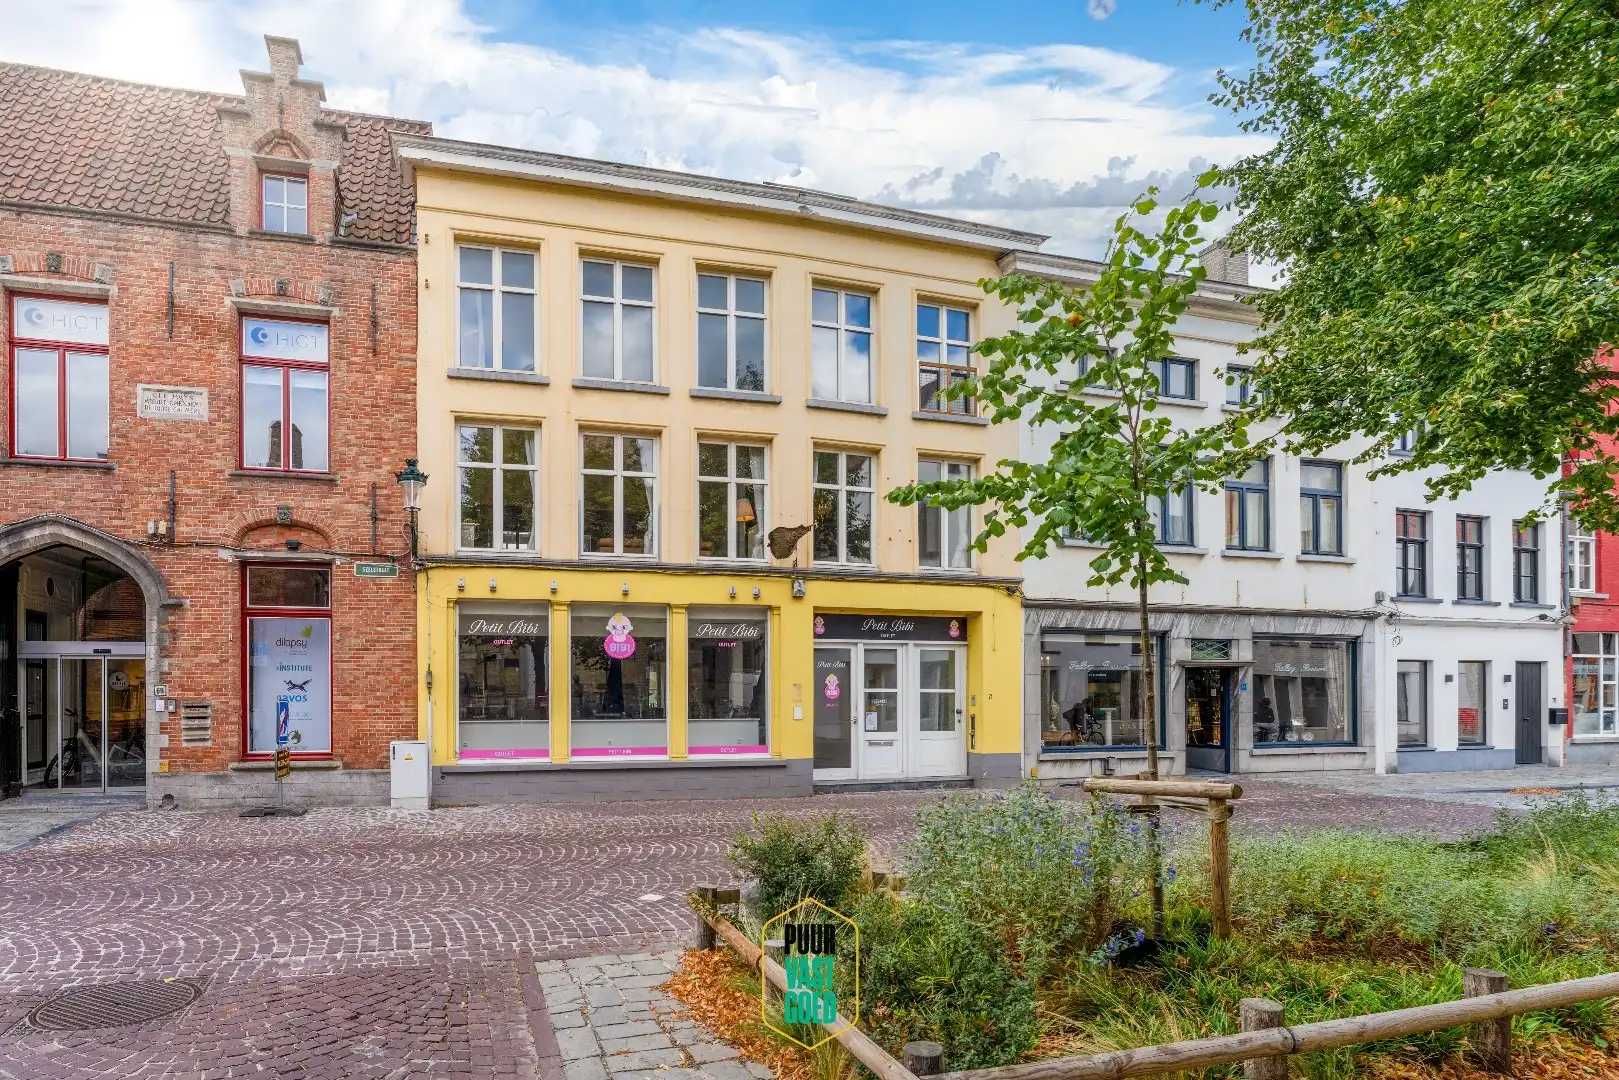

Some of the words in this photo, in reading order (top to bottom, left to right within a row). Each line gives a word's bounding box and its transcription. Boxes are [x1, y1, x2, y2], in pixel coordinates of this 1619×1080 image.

[52, 313, 103, 331] HICT
[276, 332, 317, 349] HICT
[468, 619, 503, 634] Petit
[506, 619, 539, 634] Bibi
[695, 623, 728, 637] Petit
[729, 623, 759, 637] Bibi
[861, 618, 888, 631] Petit
[890, 618, 915, 632] Bibi
[275, 637, 308, 649] dilapsy
[609, 643, 631, 653] BIBI
